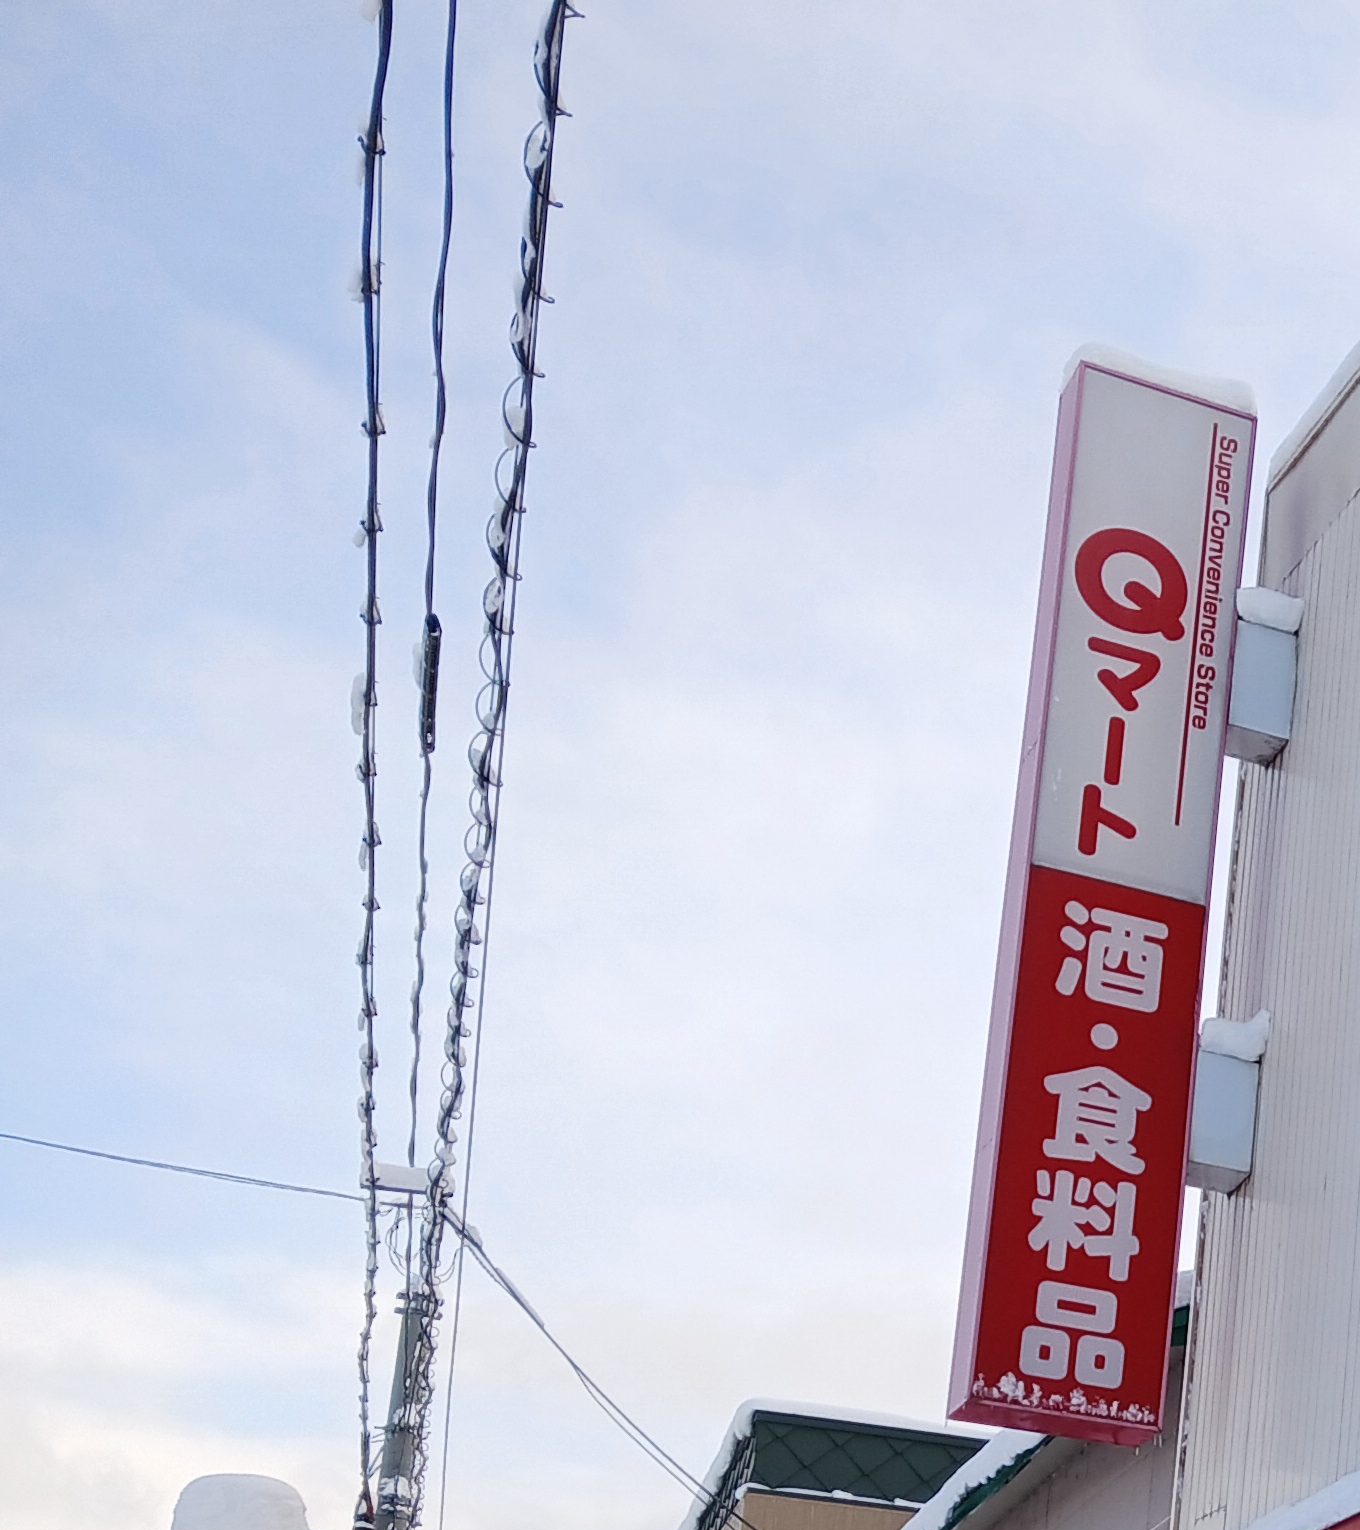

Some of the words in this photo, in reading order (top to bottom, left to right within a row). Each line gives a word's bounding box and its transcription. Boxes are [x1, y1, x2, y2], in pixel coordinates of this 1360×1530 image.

[1213, 434, 1239, 505] Super
[1198, 508, 1231, 658] Convenience
[1073, 527, 1189, 857] Qマート
[1191, 663, 1216, 732] Store
[1019, 899, 1170, 1391] 酒・食料品
